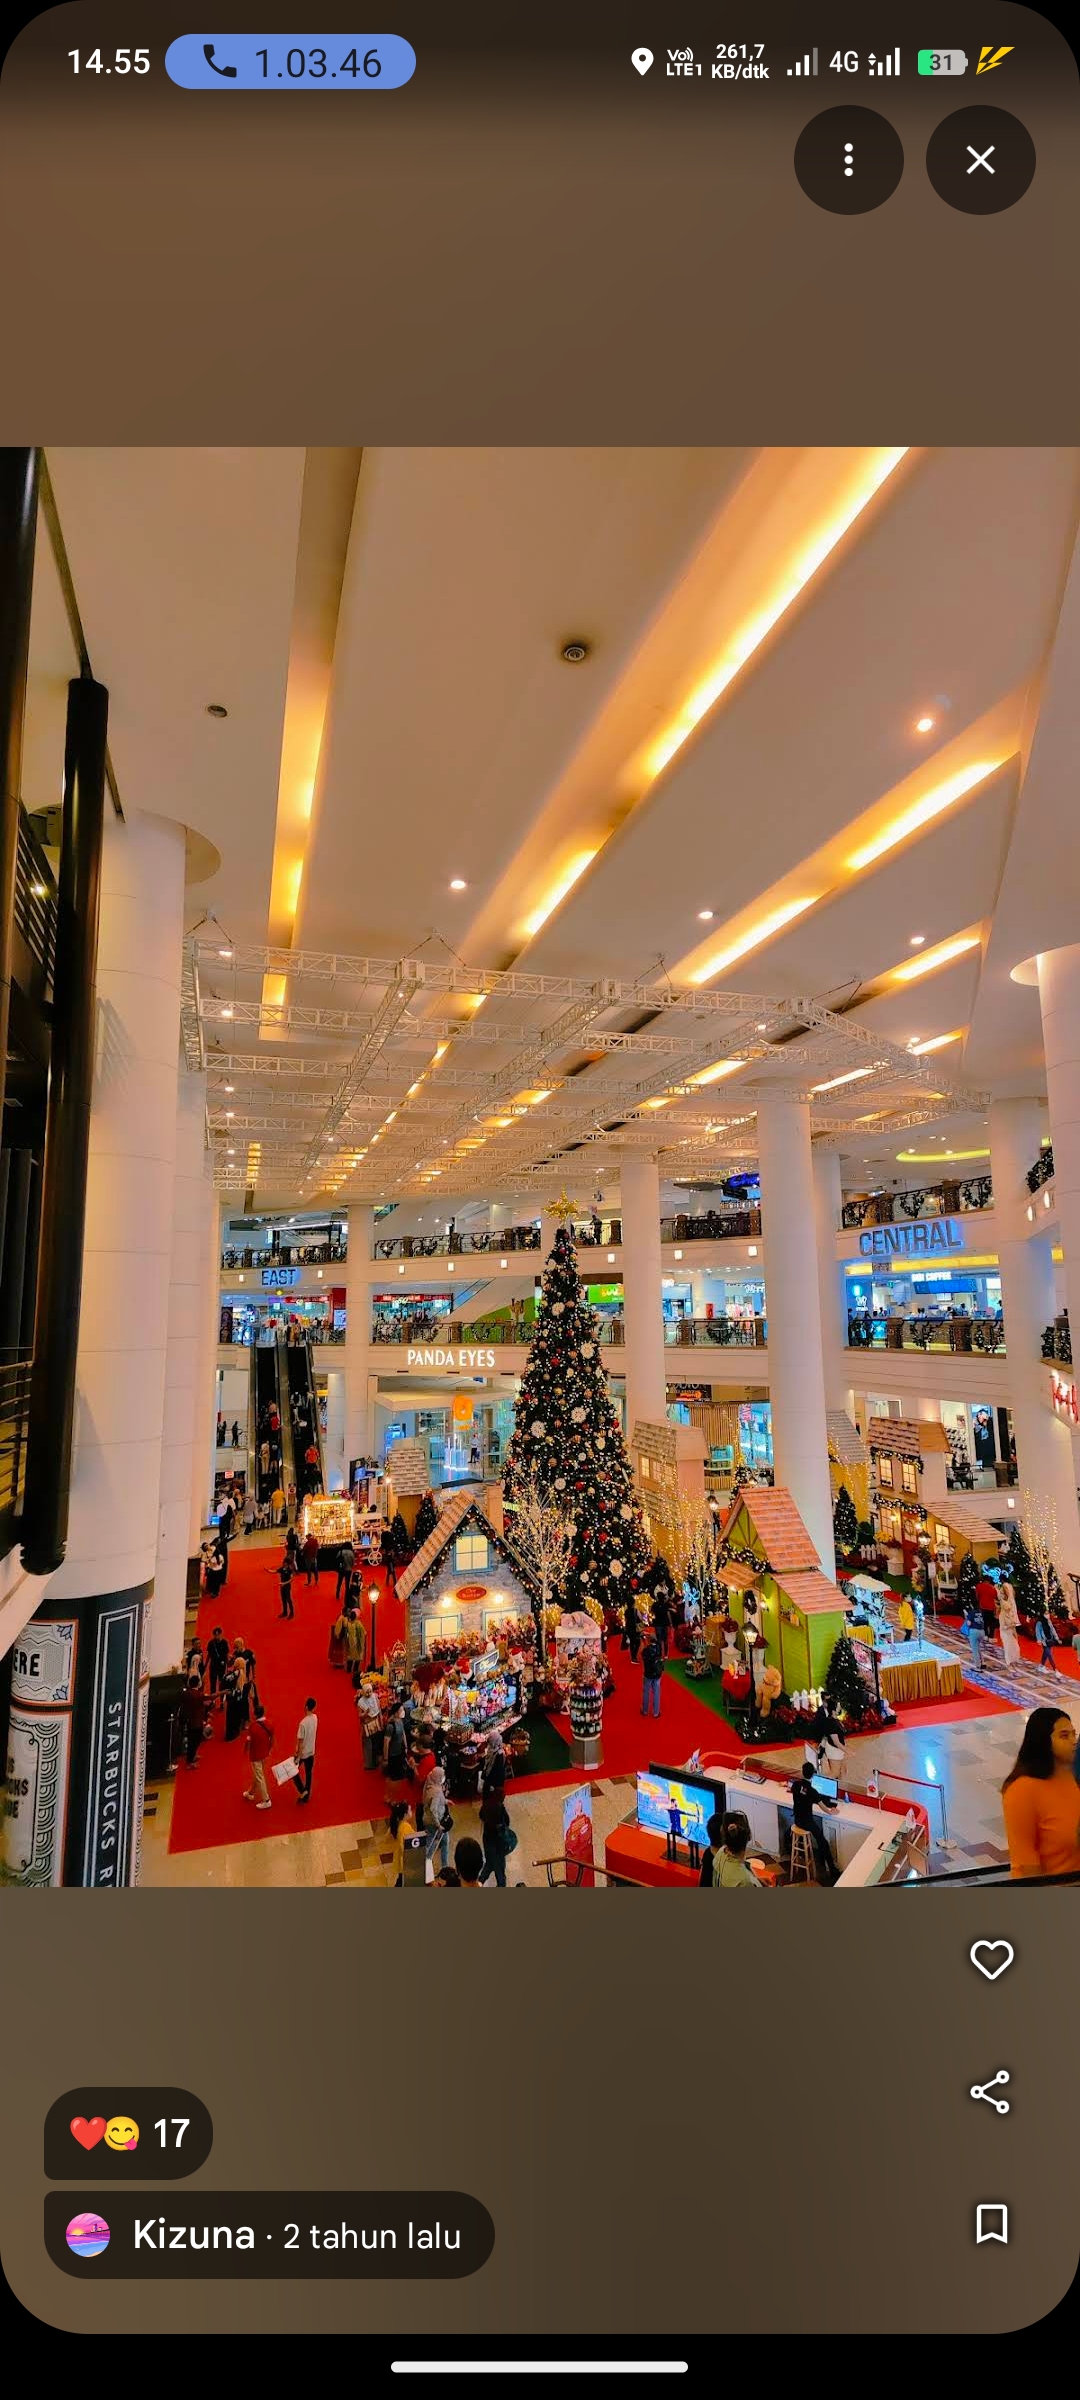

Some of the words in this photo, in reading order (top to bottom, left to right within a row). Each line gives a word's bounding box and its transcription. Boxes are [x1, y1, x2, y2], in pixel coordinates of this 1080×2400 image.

[859, 1220, 962, 1256] CENTRAL
[261, 1269, 296, 1286] EAST
[407, 1349, 454, 1366] PANDA
[459, 1350, 495, 1367] EYES
[101, 1702, 122, 1850] STARBUCKS
[411, 1837, 420, 1848] G
